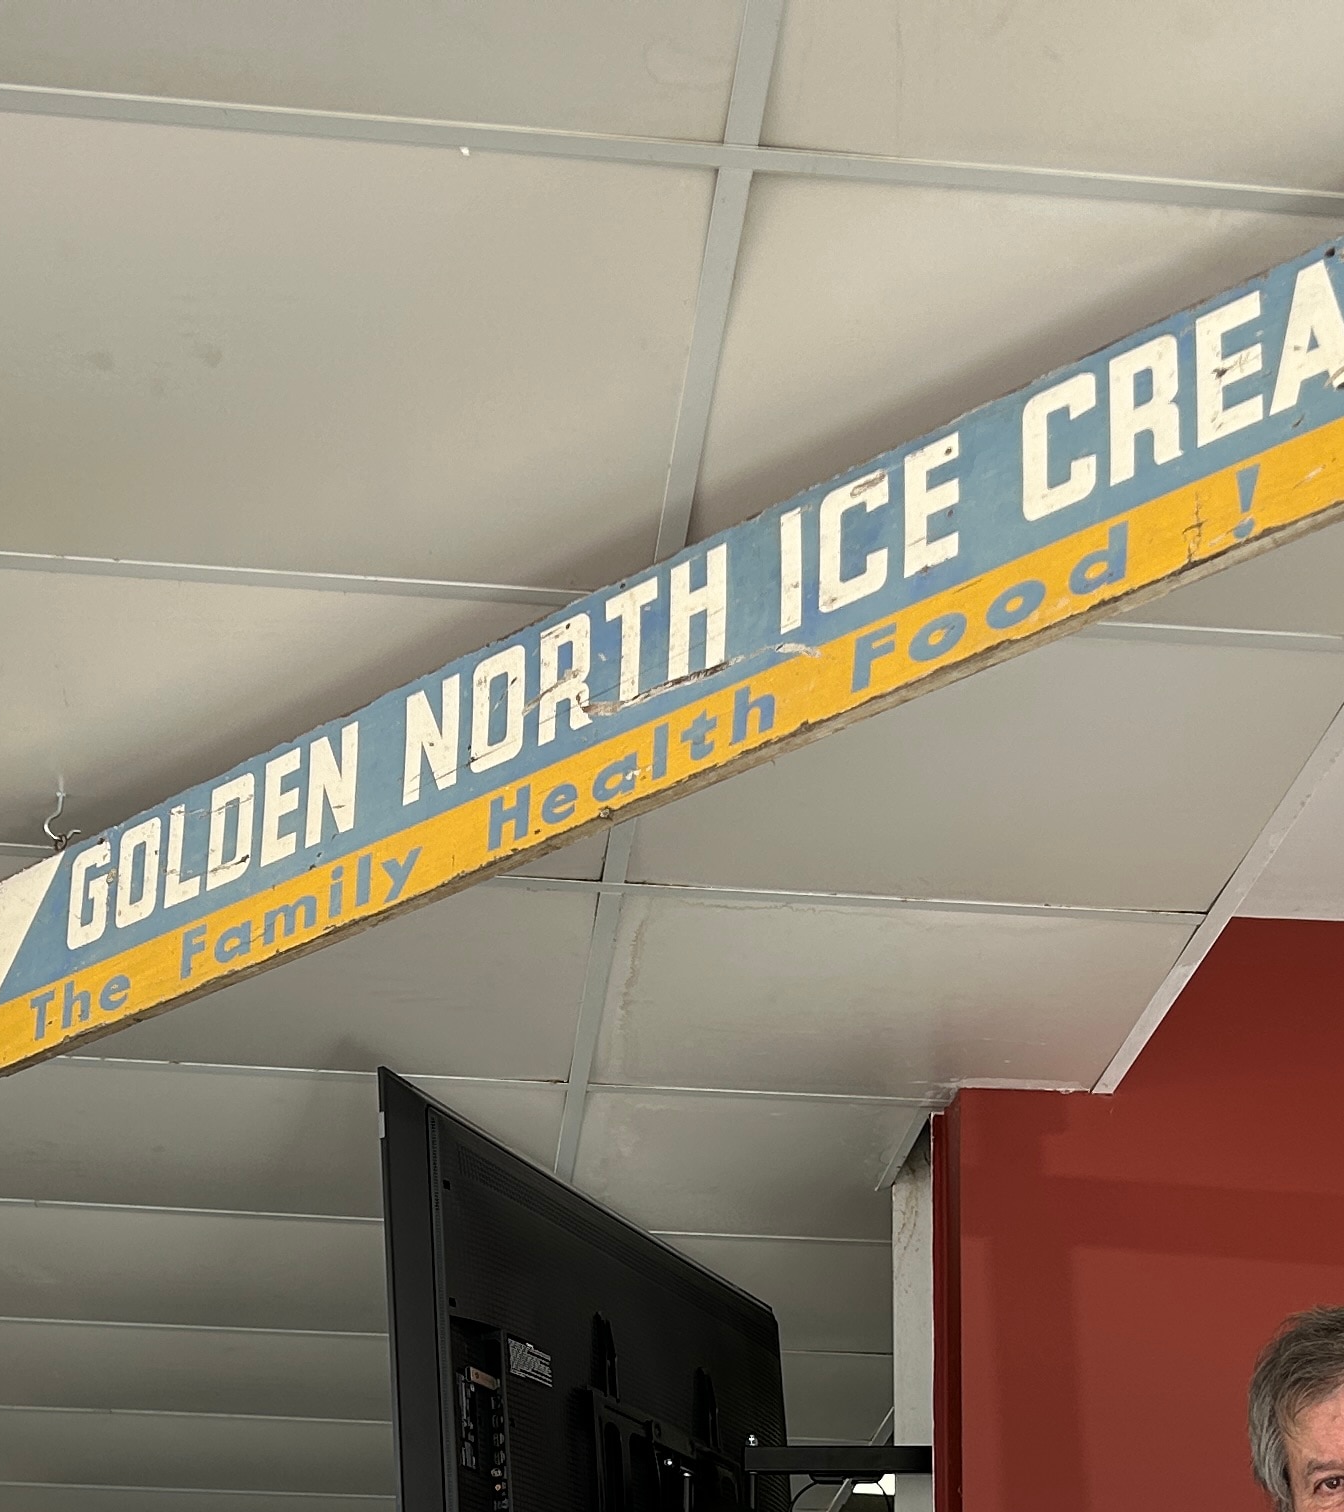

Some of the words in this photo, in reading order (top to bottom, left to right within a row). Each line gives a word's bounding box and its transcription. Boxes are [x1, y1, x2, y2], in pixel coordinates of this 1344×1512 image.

[29, 973, 130, 1040] The
[178, 843, 423, 981] Family
[488, 685, 775, 852] Health
[851, 521, 1128, 695] Food
[66, 720, 360, 951] GOLDEN
[402, 543, 727, 807] NORTH
[779, 434, 961, 635] ICE
